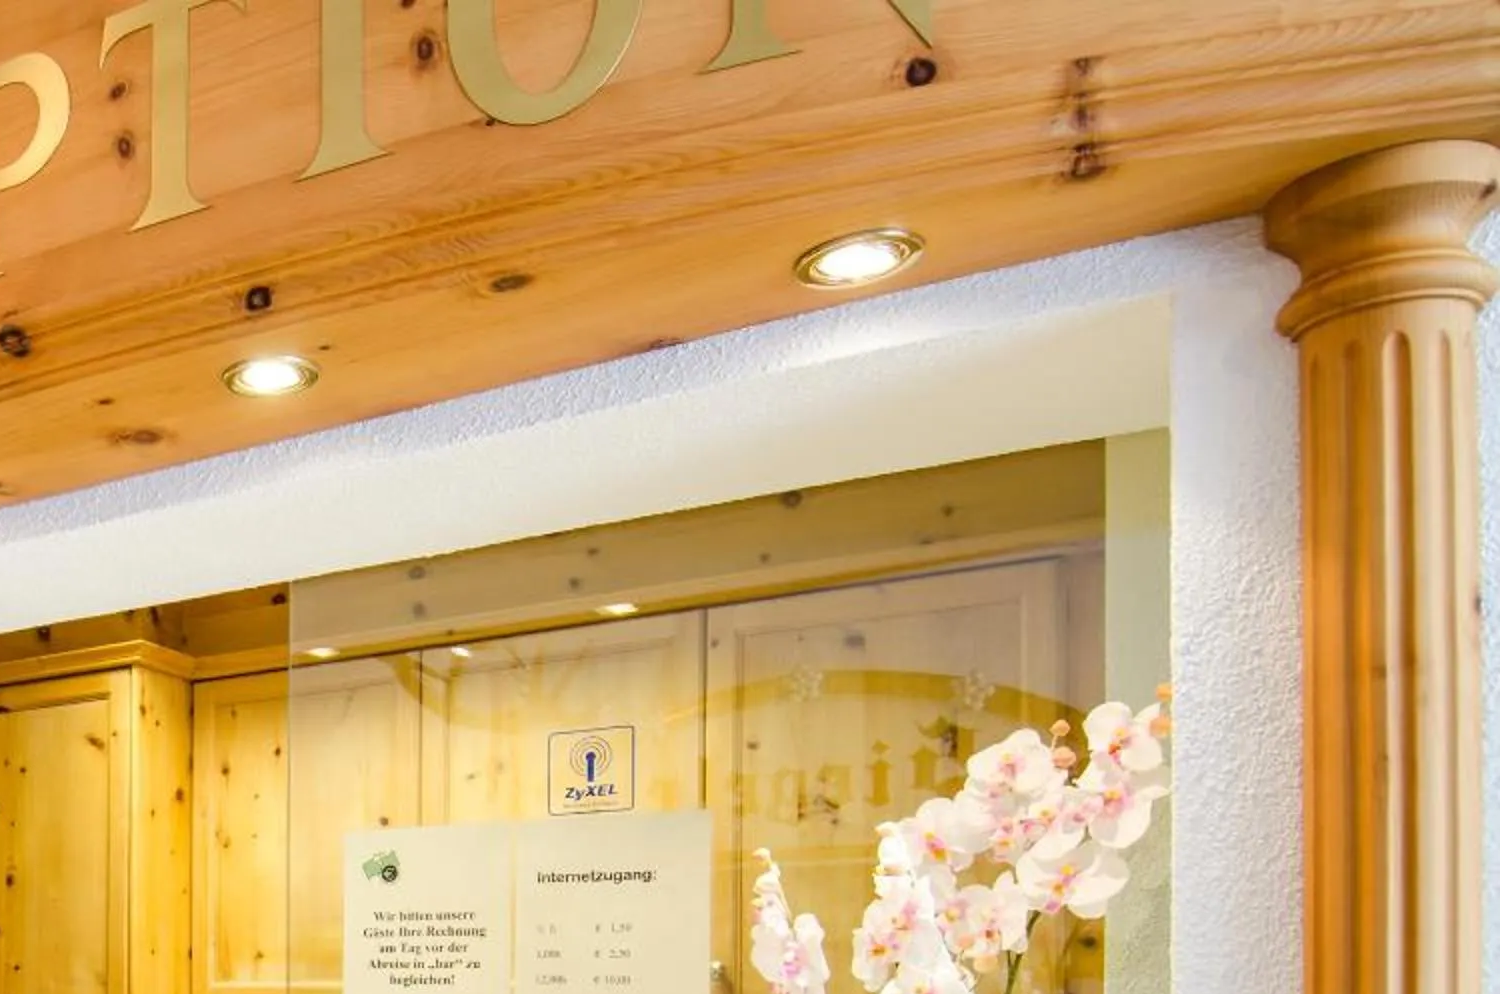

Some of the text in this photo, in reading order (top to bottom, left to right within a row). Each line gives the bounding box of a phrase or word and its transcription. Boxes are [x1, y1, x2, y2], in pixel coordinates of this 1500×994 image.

[564, 783, 619, 800] ZyXEL
[373, 911, 396, 922] Wir
[435, 911, 476, 922] unsere
[426, 925, 487, 938] Rechnung
[379, 944, 397, 954] am
[447, 942, 469, 953] der
[413, 958, 425, 970] in
